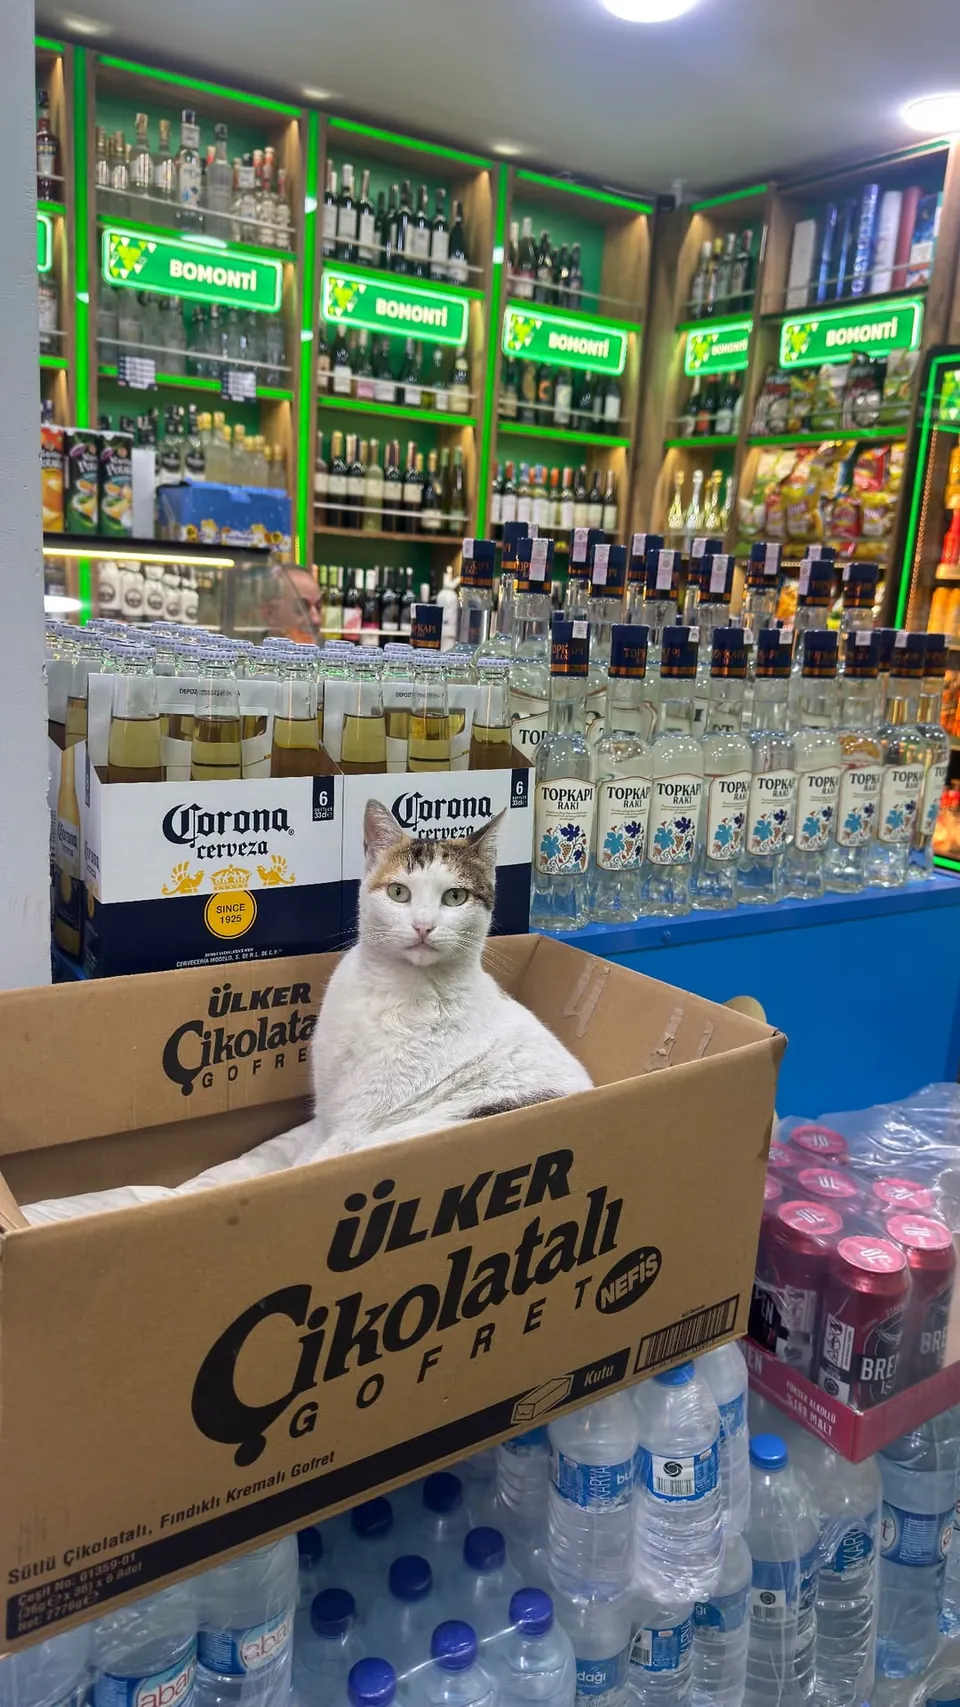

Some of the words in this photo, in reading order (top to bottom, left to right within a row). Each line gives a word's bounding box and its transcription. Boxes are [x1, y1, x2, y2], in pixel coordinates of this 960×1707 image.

[319, 790, 328, 806] 6
[516, 781, 523, 795] 6
[541, 787, 594, 802] TOPKAPI
[607, 786, 650, 800] TOPKAP
[657, 783, 701, 797] TOPKAP
[673, 796, 692, 804] RAKI
[392, 792, 492, 831] Corona
[557, 801, 580, 810] RAKI
[623, 799, 643, 808] RAKI
[162, 803, 291, 848] Corona
[197, 840, 268, 860] cerveza
[216, 903, 246, 914] SINCE
[220, 914, 242, 924] 1925
[208, 983, 311, 1018] ÜLKER
[163, 1009, 317, 1096] Çikolata
[202, 1047, 307, 1088] GOFRE
[327, 1149, 574, 1272] ÜLKER
[600, 1253, 658, 1309] NEFİS
[191, 1186, 623, 1467] Çikolatalı
[289, 1276, 593, 1438] GOFRET
[583, 1363, 614, 1387] Kutu
[810, 1412, 833, 1437] MALT
[8, 1555, 56, 1585] Sütlü
[63, 1523, 152, 1567] Çikolatalı,
[160, 1496, 220, 1529] Fındıklı
[226, 1471, 286, 1504] Kremalı
[291, 1451, 336, 1478] Gofret
